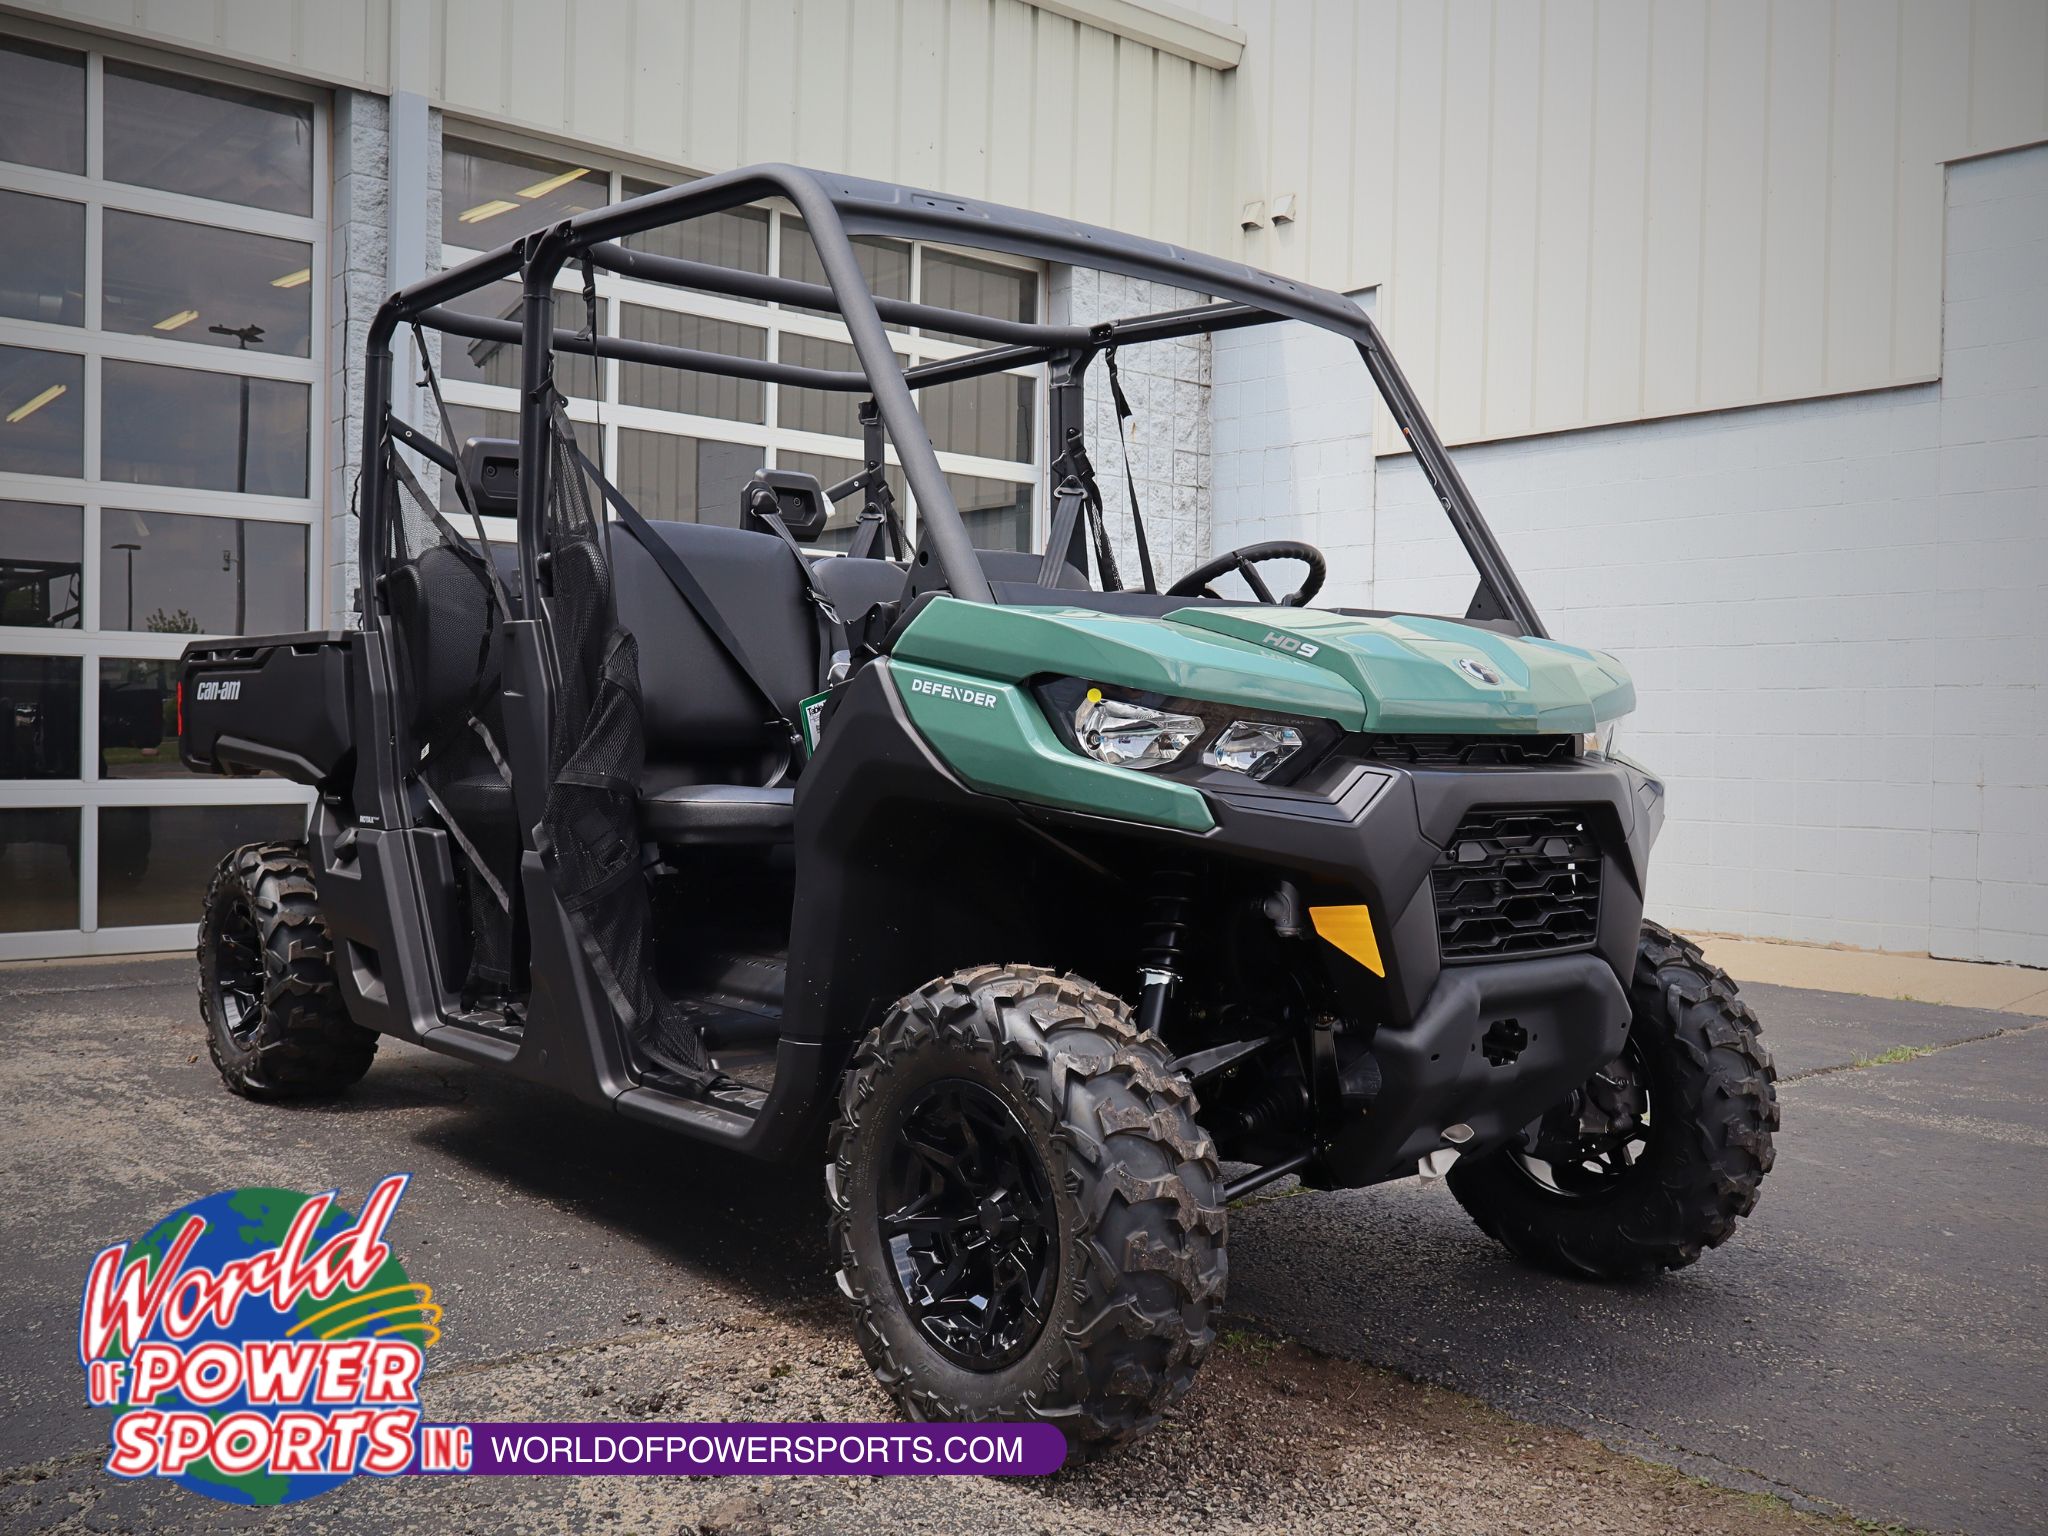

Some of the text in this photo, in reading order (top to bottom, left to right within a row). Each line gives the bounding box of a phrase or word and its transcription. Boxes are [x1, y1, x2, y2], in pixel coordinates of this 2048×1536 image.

[1263, 631, 1319, 658] HD9
[196, 680, 241, 700] can-am
[911, 678, 997, 708] DEFENDER
